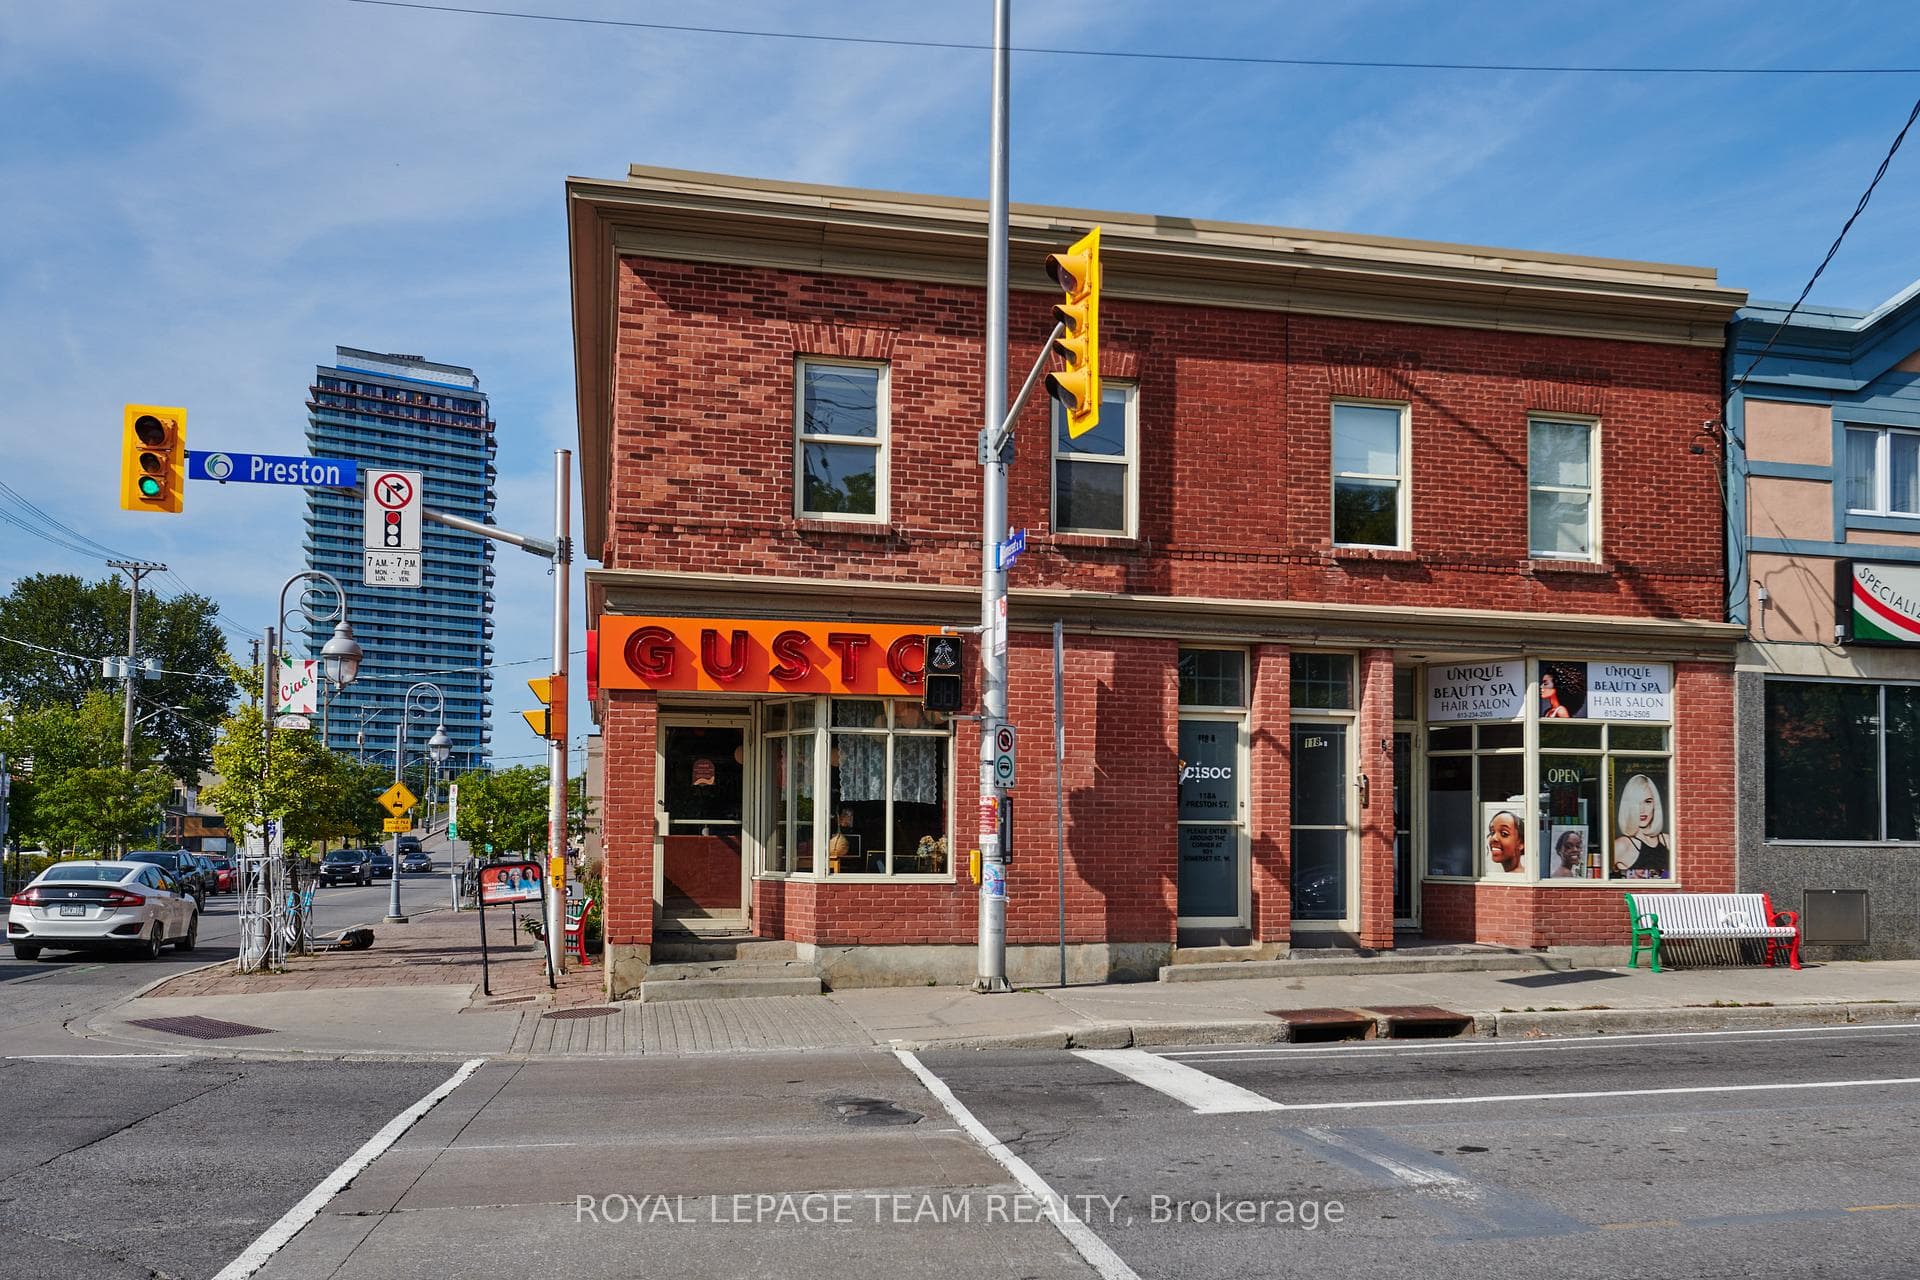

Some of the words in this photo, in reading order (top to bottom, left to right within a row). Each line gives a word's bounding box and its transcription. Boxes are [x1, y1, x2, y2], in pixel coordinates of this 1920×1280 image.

[250, 456, 340, 485] Preston
[367, 556, 373, 567] 7
[396, 557, 402, 567] 7
[1447, 664, 1504, 682] UNIQUE
[1605, 665, 1652, 680] UNIQUE
[281, 668, 315, 702] Ciao!
[1433, 683, 1486, 700] BEAUTY
[1490, 683, 1518, 697] SPA
[1594, 681, 1637, 693] BEAUTY
[1641, 682, 1663, 694] SPA
[1441, 701, 1469, 712] HAIR
[1472, 698, 1511, 711] SALON
[1593, 696, 1622, 707] HAIR
[1626, 697, 1664, 708] SALON
[1604, 709, 1651, 718] 613-234-2505
[1547, 768, 1580, 783] OPEN
